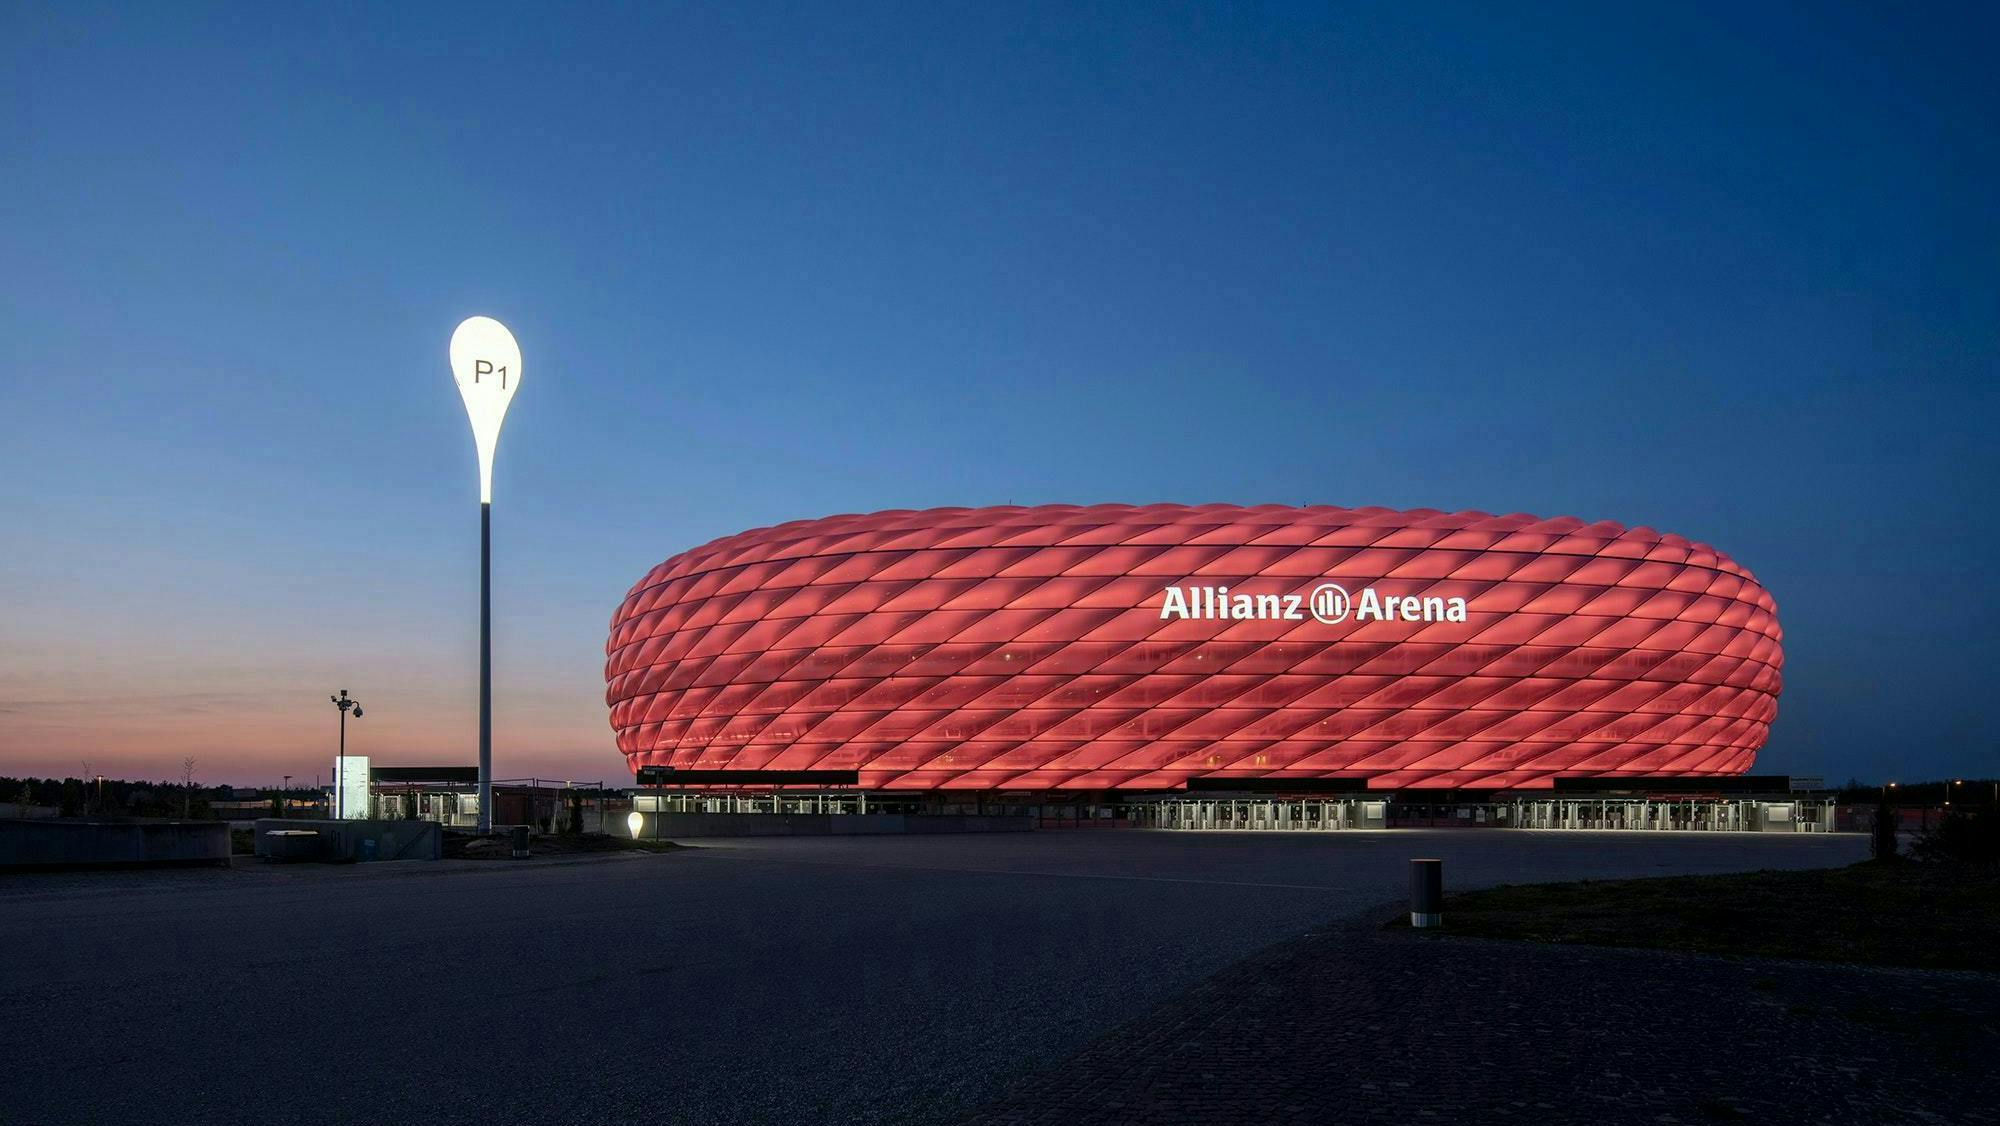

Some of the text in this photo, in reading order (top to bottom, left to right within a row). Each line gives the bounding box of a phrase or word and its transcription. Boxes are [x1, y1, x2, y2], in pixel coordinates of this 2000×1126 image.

[475, 359, 507, 391] P1
[1159, 586, 1467, 622] Allianz Arena
